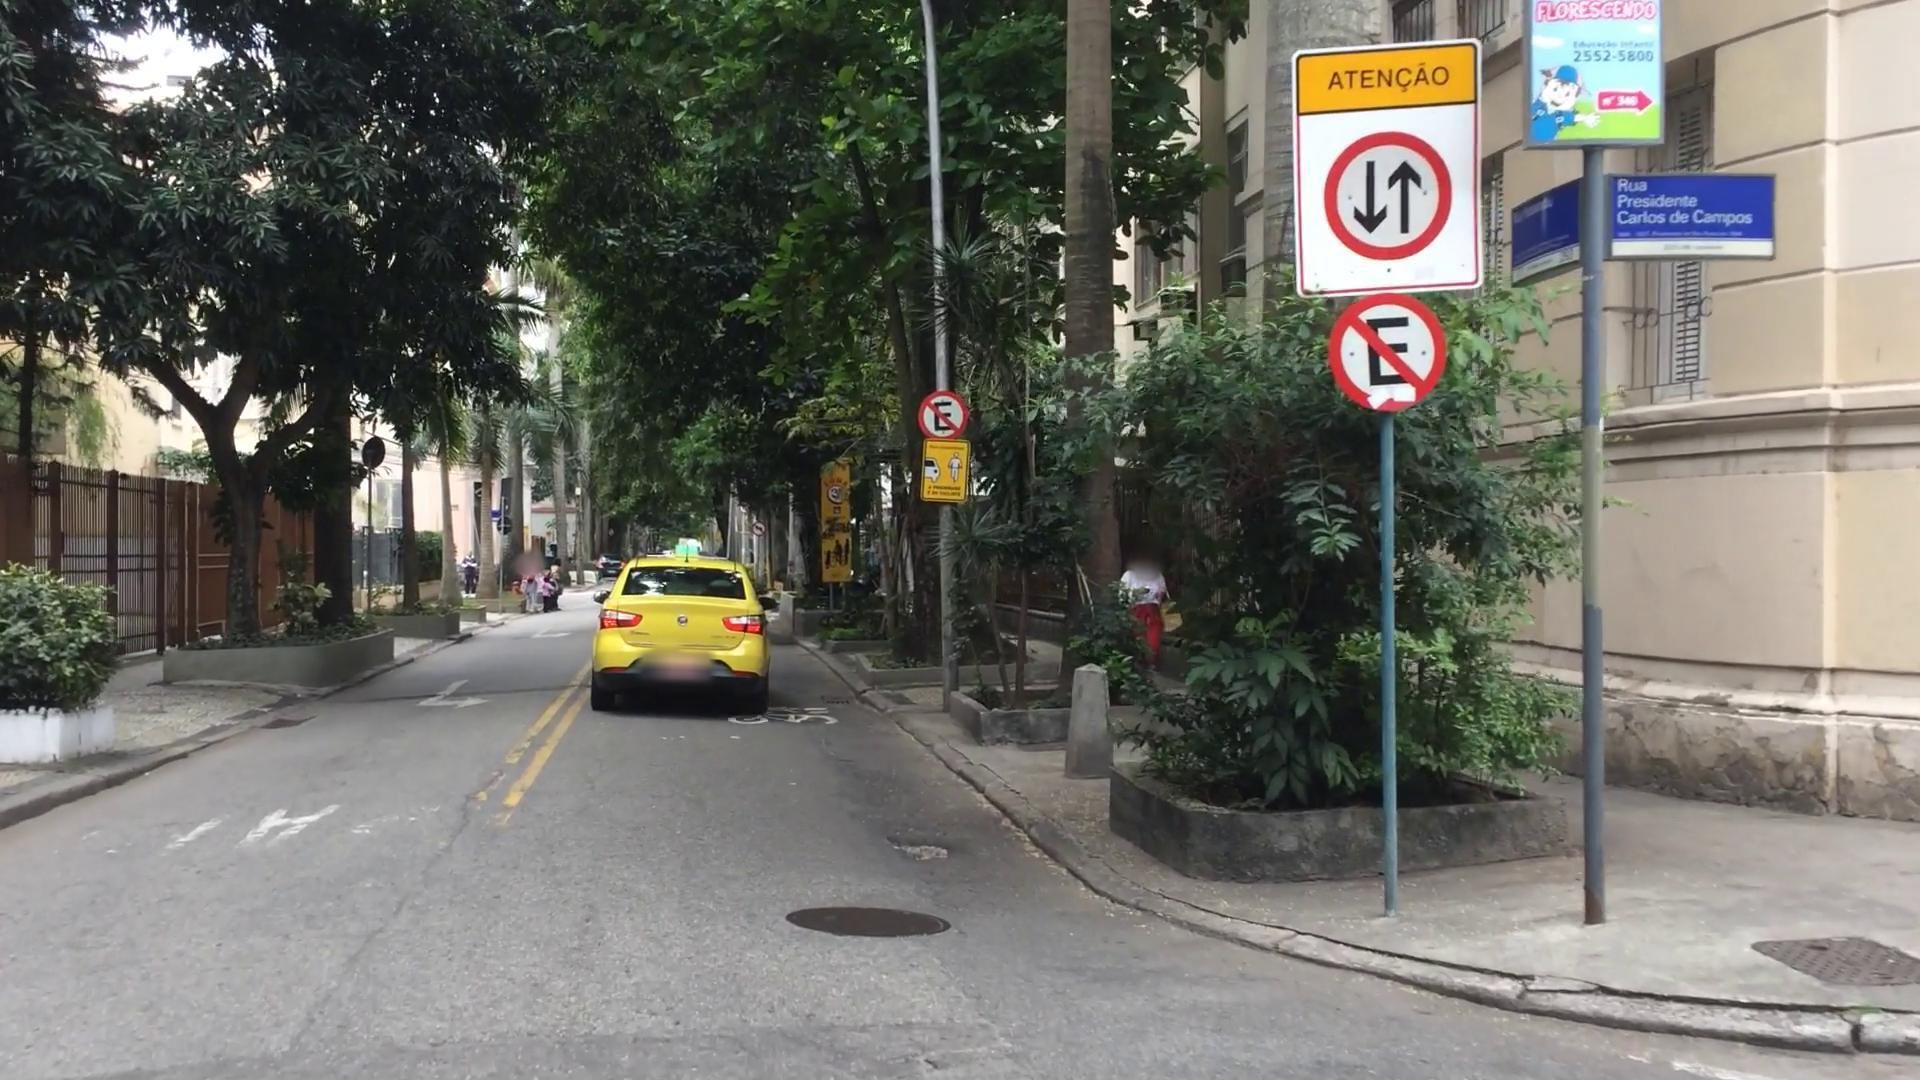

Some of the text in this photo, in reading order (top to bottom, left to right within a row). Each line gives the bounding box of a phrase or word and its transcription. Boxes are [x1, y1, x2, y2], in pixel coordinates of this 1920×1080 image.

[1536, 0, 1657, 22] FLORESCENDO
[1573, 50, 1654, 62] 2552-5800
[1327, 63, 1450, 92] ATENÇÃO
[1617, 178, 1648, 192] Rua
[1617, 194, 1698, 208] Presidente
[1617, 209, 1753, 227] Carlos de Campos
[1367, 317, 1409, 386] E
[934, 401, 952, 431] E
